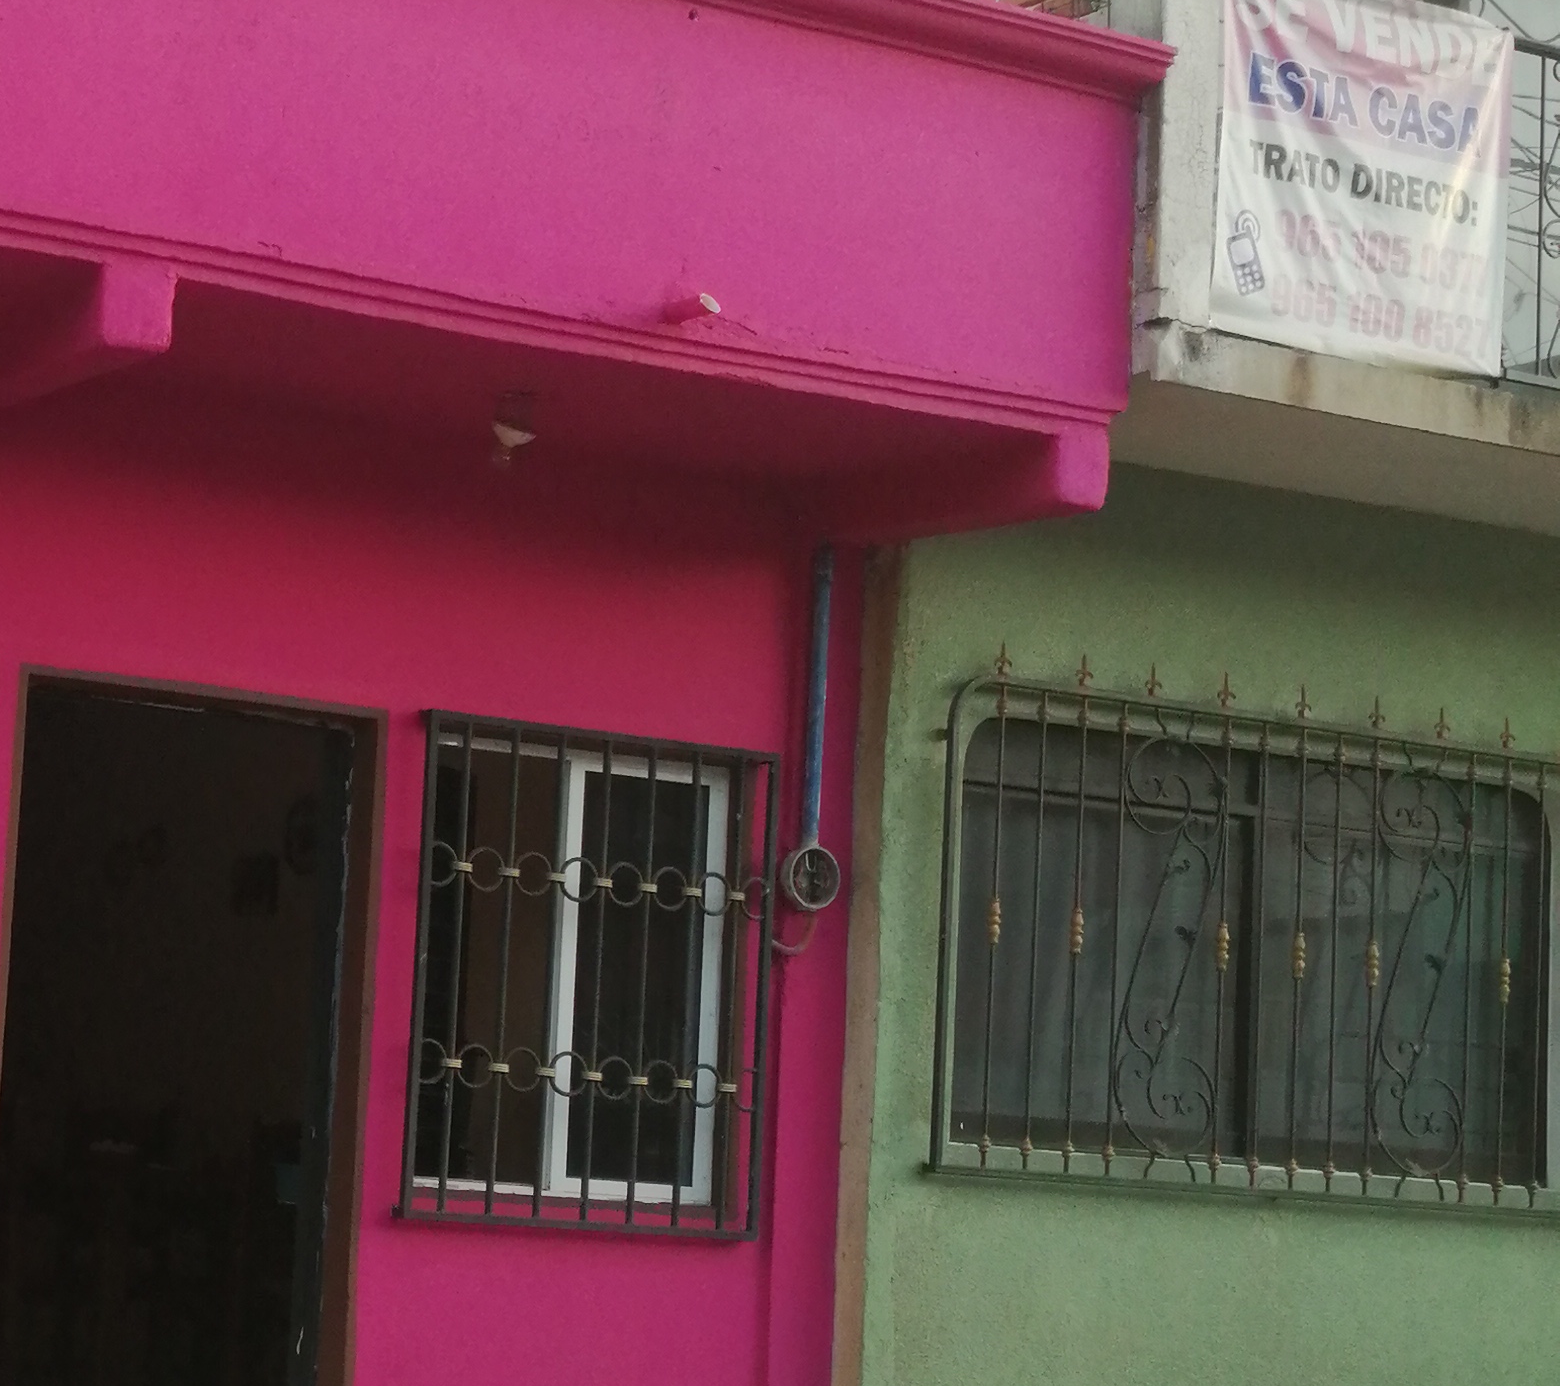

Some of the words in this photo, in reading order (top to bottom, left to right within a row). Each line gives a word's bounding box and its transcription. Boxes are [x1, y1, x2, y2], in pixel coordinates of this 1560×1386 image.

[1248, 52, 1359, 128] ESTA
[1368, 86, 1482, 159] CASA
[1250, 139, 1340, 193] TRATO
[1350, 162, 1478, 226] DIRECTO:
[1272, 274, 1338, 327] 965
[1348, 291, 1406, 342] 100
